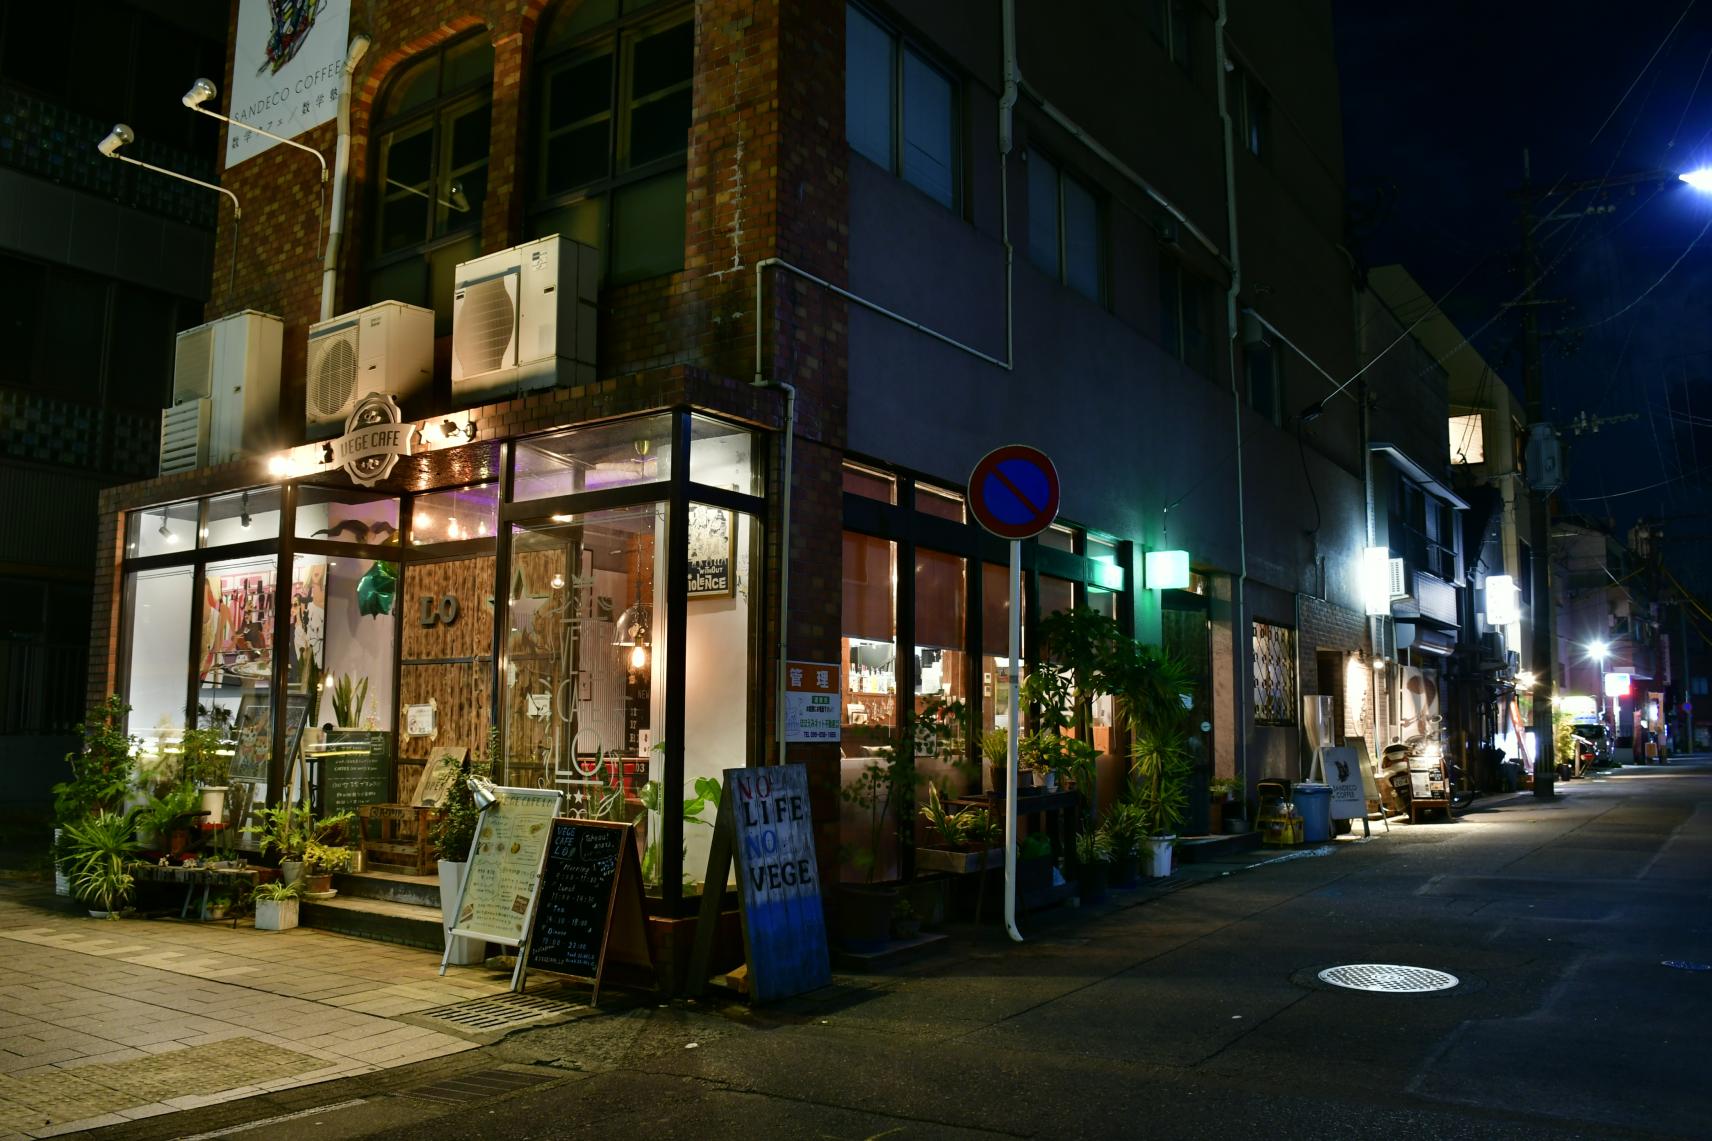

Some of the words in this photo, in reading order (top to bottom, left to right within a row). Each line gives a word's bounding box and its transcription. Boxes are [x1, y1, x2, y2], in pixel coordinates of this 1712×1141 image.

[234, 87, 290, 122] SANDECO
[295, 59, 341, 94] COFFEE
[340, 434, 369, 459] VEGE
[371, 430, 400, 448] CAFE
[420, 595, 457, 625] LO
[790, 668, 829, 689] 管理
[737, 775, 771, 799] NO
[744, 797, 804, 827] LIFE
[555, 837, 575, 847] CAFE
[557, 826, 577, 837] VEGE
[747, 830, 777, 860] NO
[749, 860, 811, 892] VEGE
